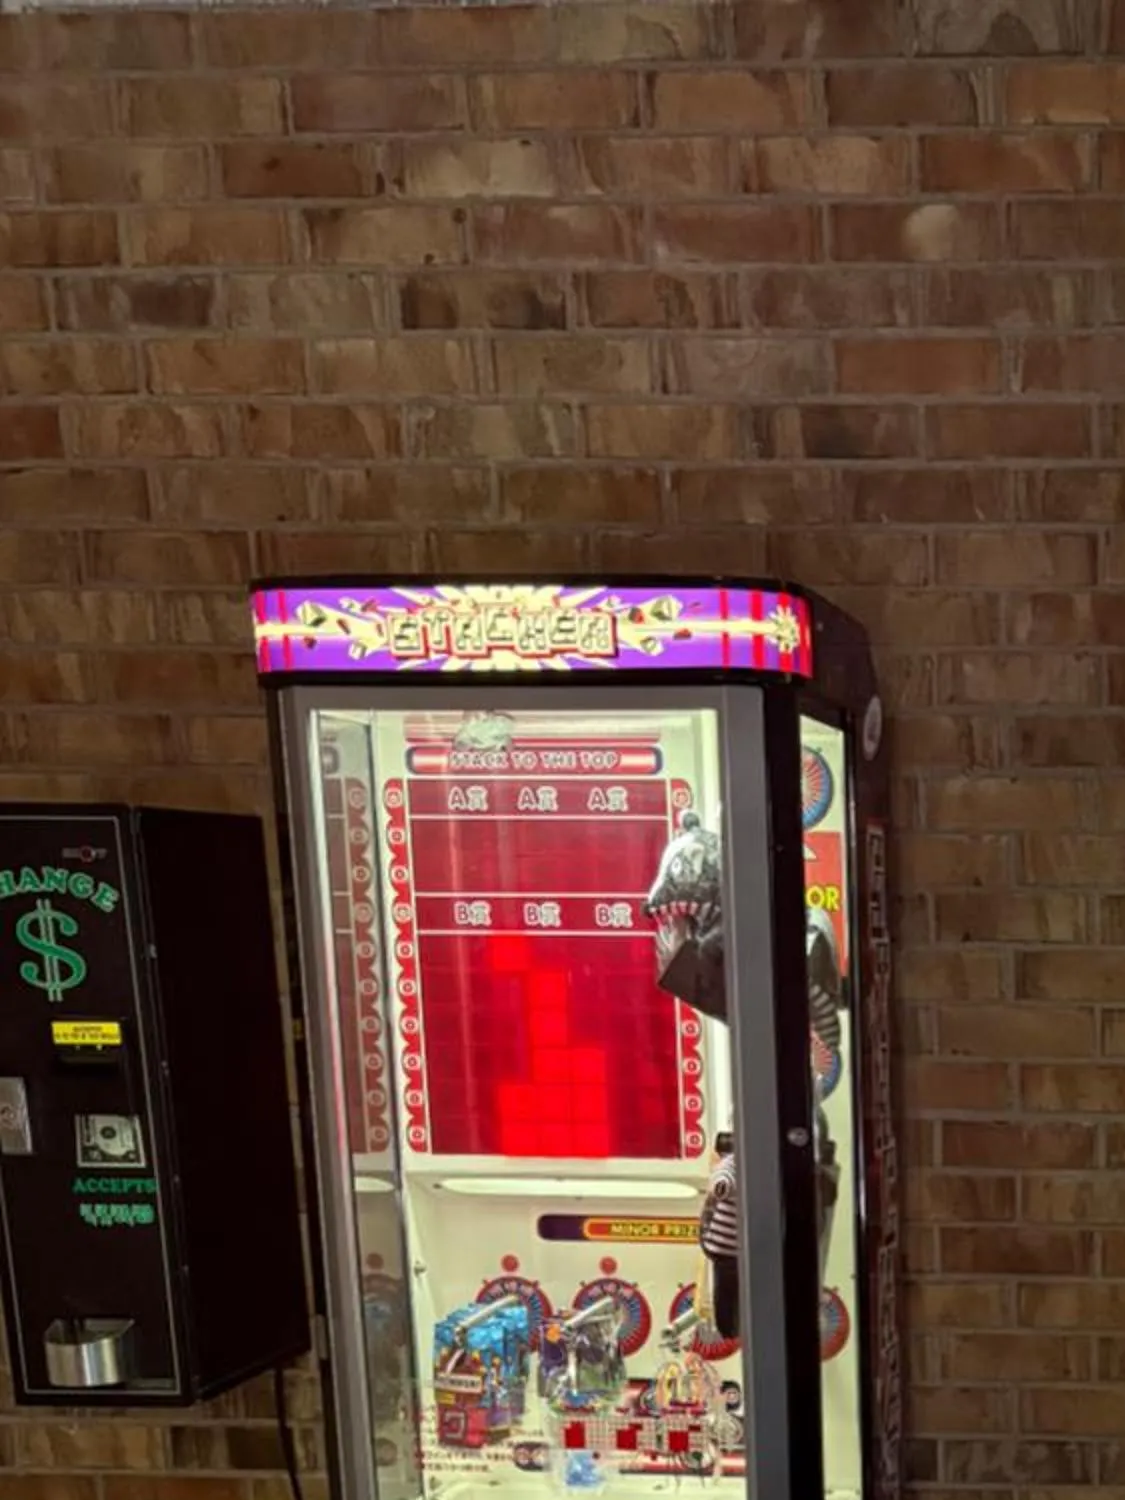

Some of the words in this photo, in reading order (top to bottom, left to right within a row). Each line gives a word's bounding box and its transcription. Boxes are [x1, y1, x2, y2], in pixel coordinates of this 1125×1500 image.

[450, 750, 509, 770] STACK
[511, 751, 539, 770] TO
[540, 751, 577, 770] THE
[579, 751, 620, 770] TOP
[0, 866, 120, 913] HANGE
[72, 1177, 157, 1194] ACCEPTS
[611, 1222, 659, 1235] MINOR
[664, 1223, 699, 1236] PRIZ
